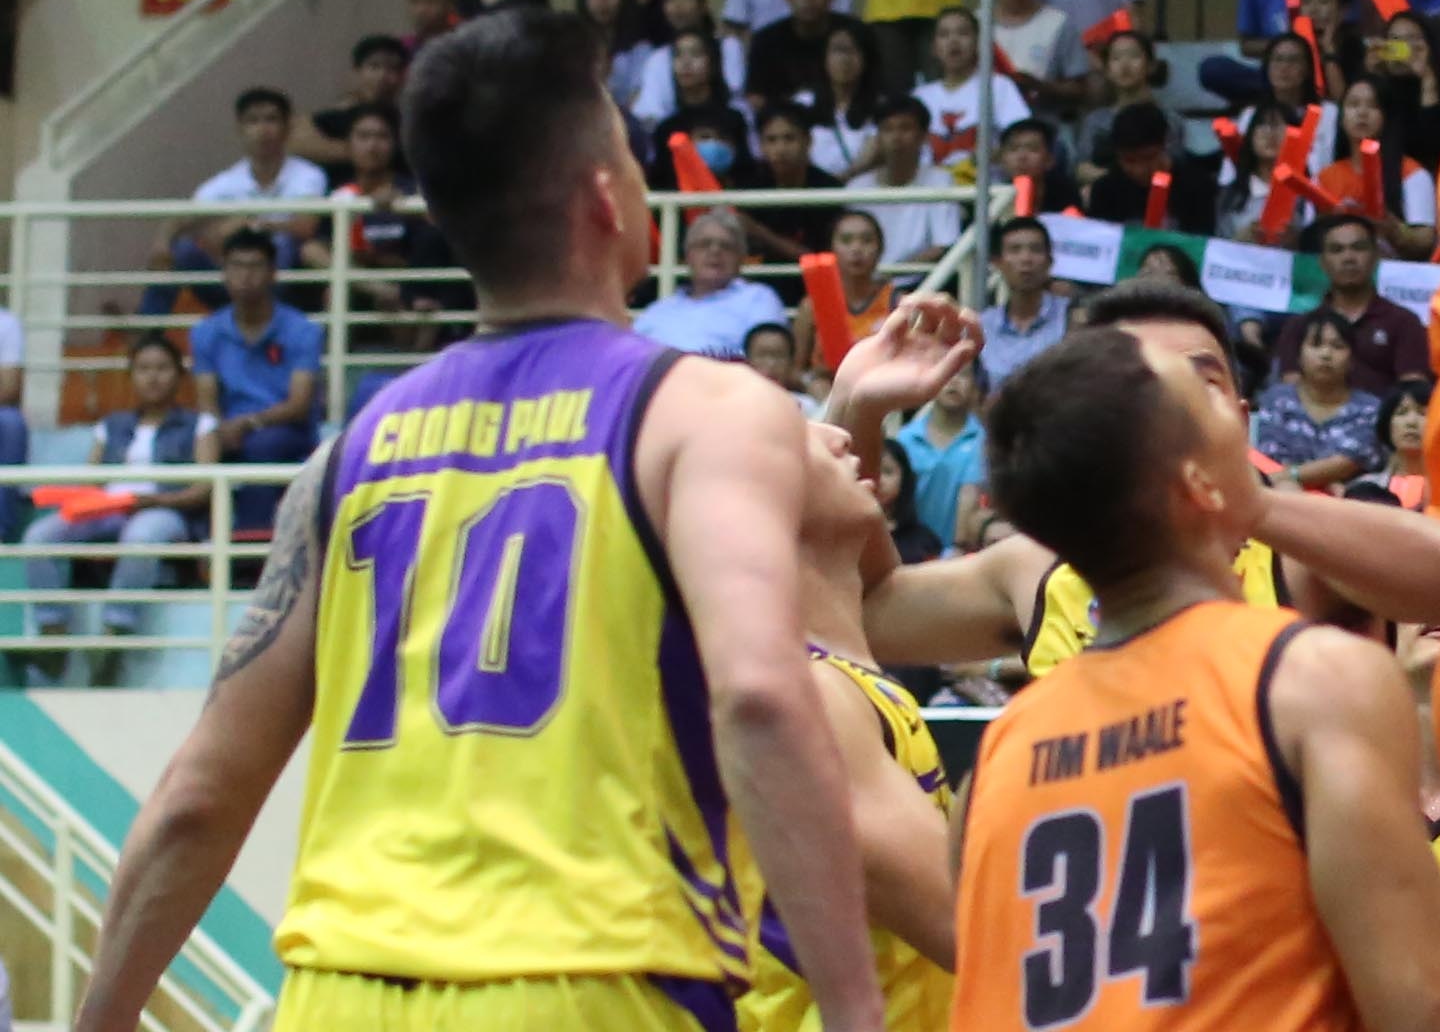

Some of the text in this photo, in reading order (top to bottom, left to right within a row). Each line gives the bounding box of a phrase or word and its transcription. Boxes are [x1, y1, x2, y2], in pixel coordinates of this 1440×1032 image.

[368, 387, 593, 466] CHONG PAUL
[339, 473, 587, 751] 10
[1029, 698, 1188, 788] TIM WAALE
[1019, 780, 1201, 1031] 34
